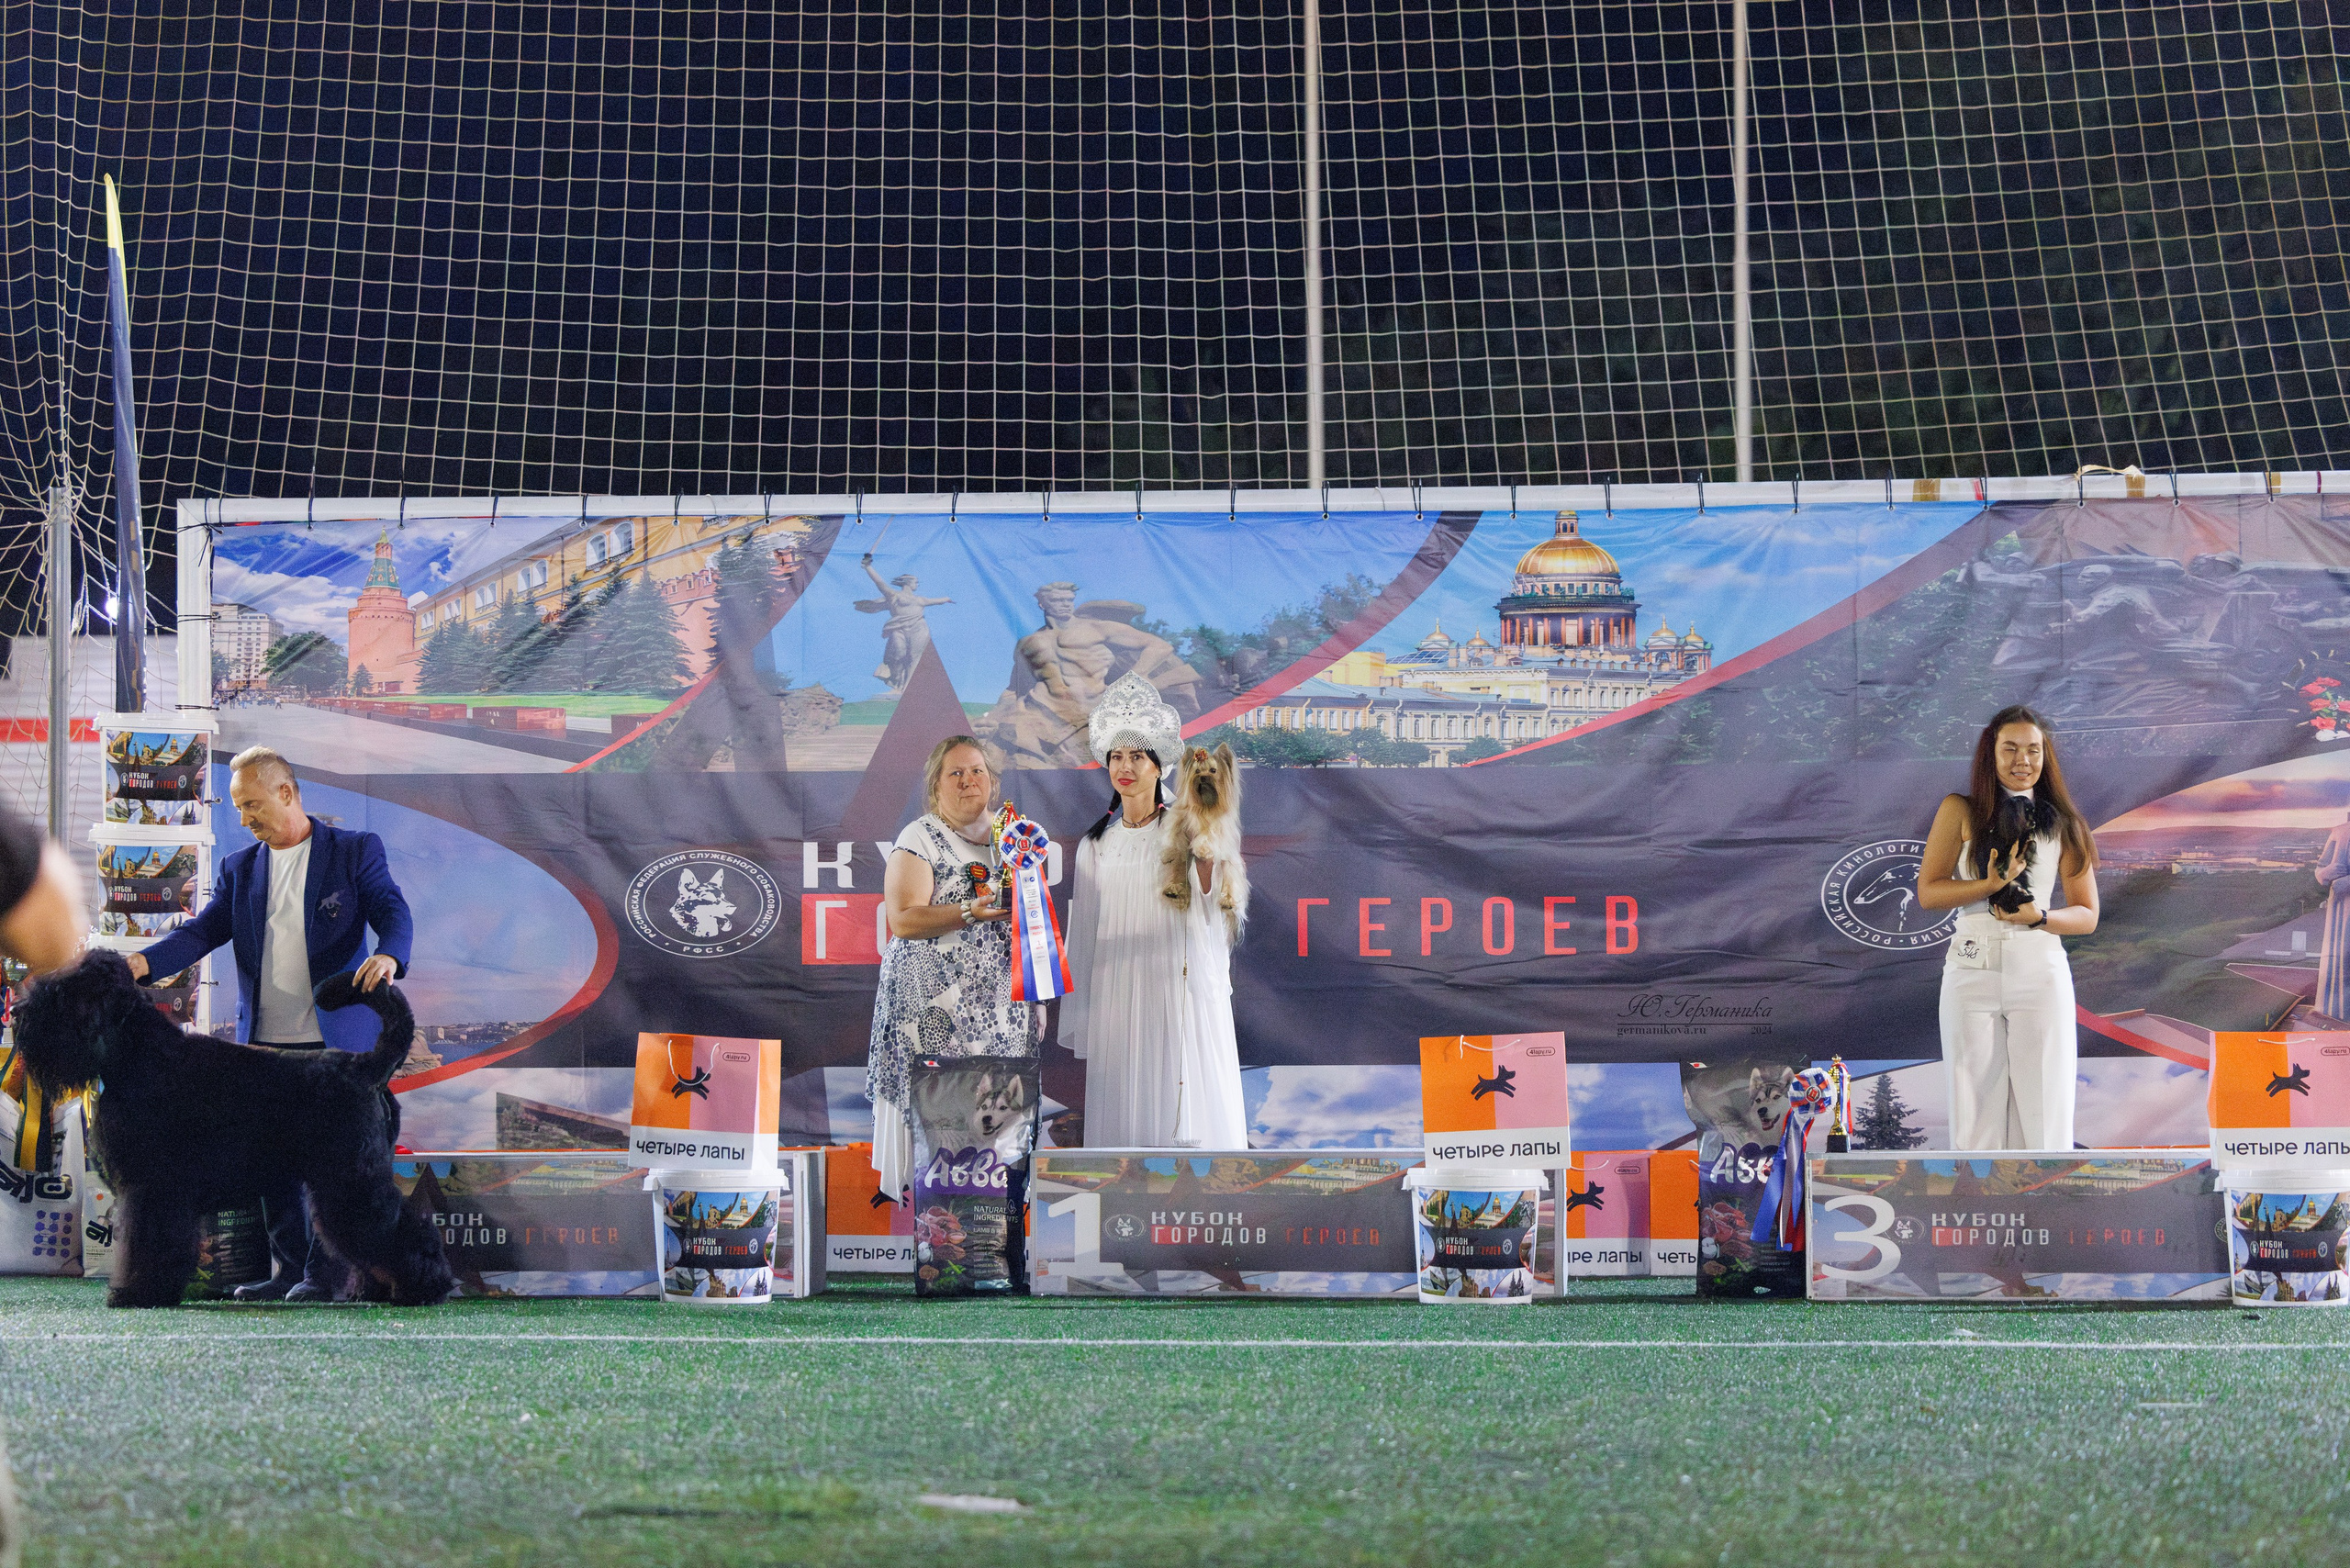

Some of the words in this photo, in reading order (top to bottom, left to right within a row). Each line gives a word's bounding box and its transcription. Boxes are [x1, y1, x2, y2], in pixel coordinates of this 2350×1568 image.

[688, 852, 758, 875] СЛУЖЕБНОГО
[1836, 844, 1919, 877] КИНОЛОГИ
[636, 854, 687, 889] ФЕДЕРАЦИЯ
[631, 889, 656, 938] РОССИЙСКАЯ
[749, 874, 776, 937] СОБАКОВОДСТВА
[1828, 882, 1892, 945] РОССИЙСКАЯ
[1297, 895, 1639, 957] ГЕРОЕВ
[682, 946, 725, 954] РФСС
[1957, 946, 1980, 959] 548
[636, 1140, 697, 1157] четыре
[700, 1145, 745, 1160] лапы
[1432, 1144, 1505, 1159] четыре
[1510, 1141, 1561, 1157] лапы
[2224, 1141, 2299, 1156] четыре
[973, 1205, 1007, 1214] NATURAL
[1151, 1211, 1243, 1226] КУБОК
[431, 1213, 483, 1226] БОК
[973, 1214, 1019, 1224] INGREDIENTS
[1931, 1212, 2026, 1226] КУБОК
[445, 1227, 507, 1247] ОДОВ
[693, 1237, 716, 1246] КУБОК
[1047, 1193, 1125, 1277] 1
[1154, 1227, 1267, 1247] ГОРОДОВ
[1285, 1226, 1380, 1246] ГЕРОЕВ
[1445, 1237, 1469, 1246] КУБОК
[1820, 1193, 1902, 1281] 3
[1935, 1228, 2050, 1248] ГОРОДОВ
[2259, 1239, 2283, 1249] КУБОК
[833, 1247, 897, 1260] четыре
[1596, 1250, 1642, 1263] лапы
